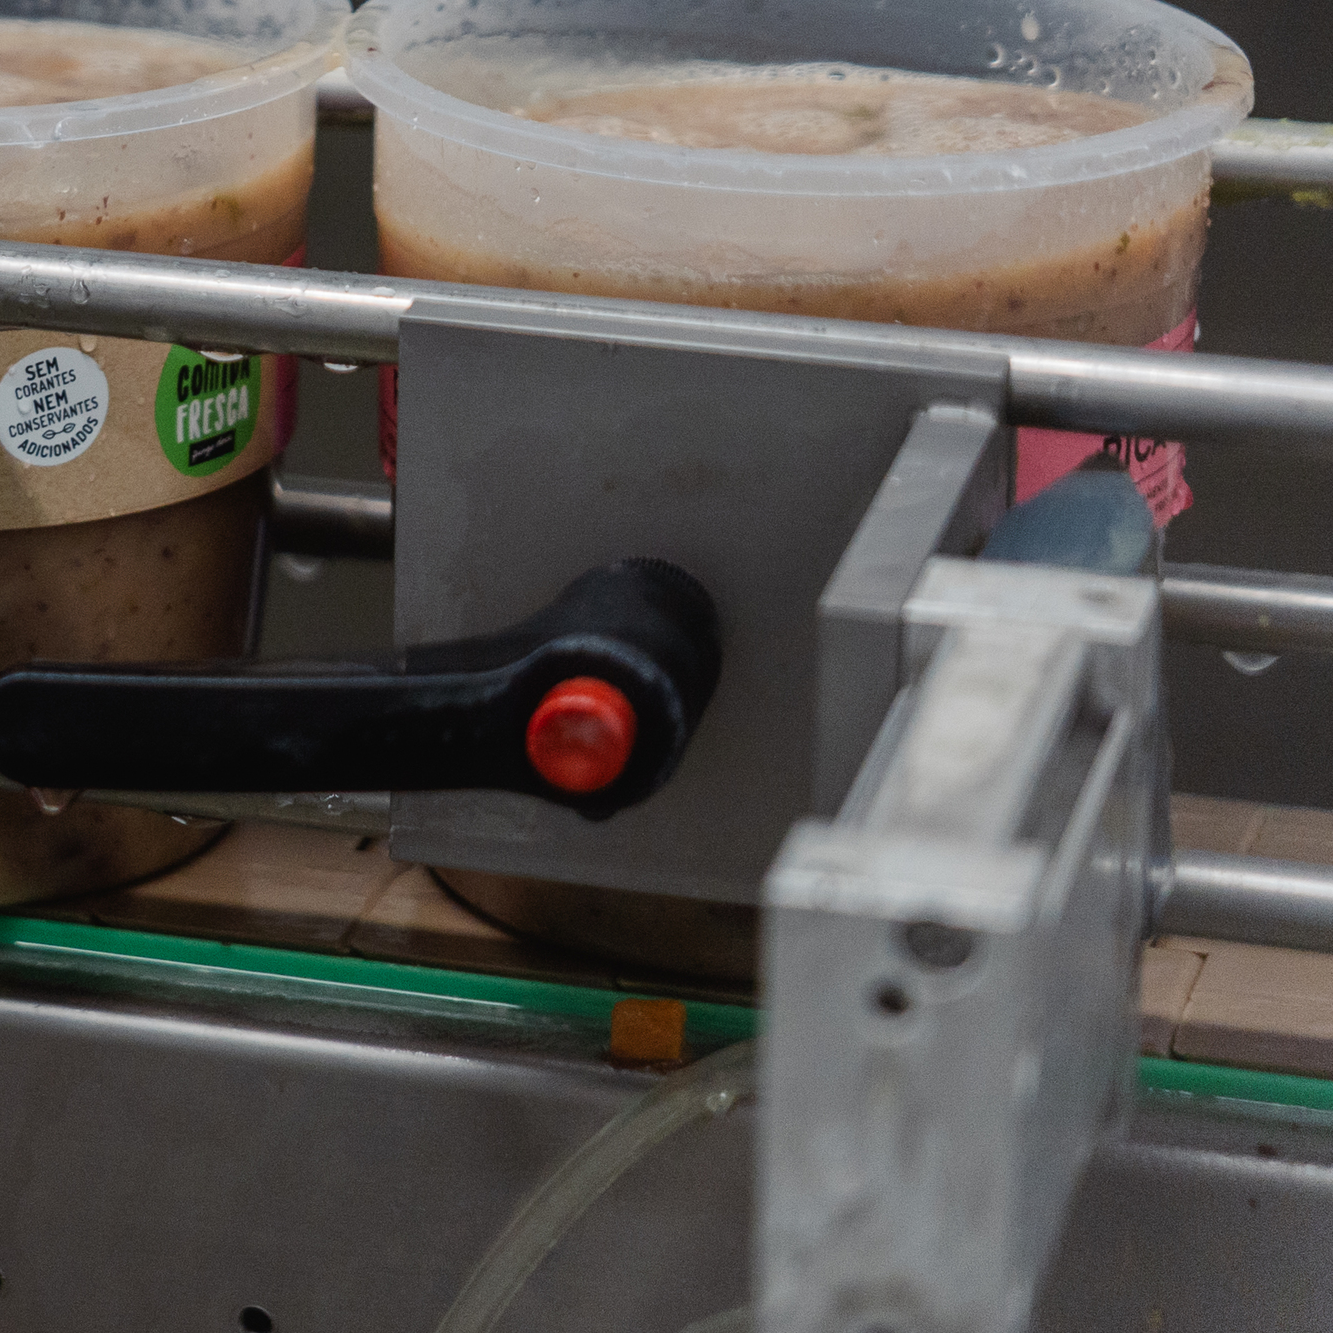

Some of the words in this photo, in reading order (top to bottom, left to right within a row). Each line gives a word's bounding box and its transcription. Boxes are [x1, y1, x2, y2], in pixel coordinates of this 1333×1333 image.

[14, 368, 77, 401] CORANTES
[25, 356, 60, 382] SEM
[8, 395, 100, 439] CONSERVANTES
[33, 388, 69, 415] NEM
[175, 384, 250, 445] FRESCA
[17, 415, 100, 459] ADICIONADOS
